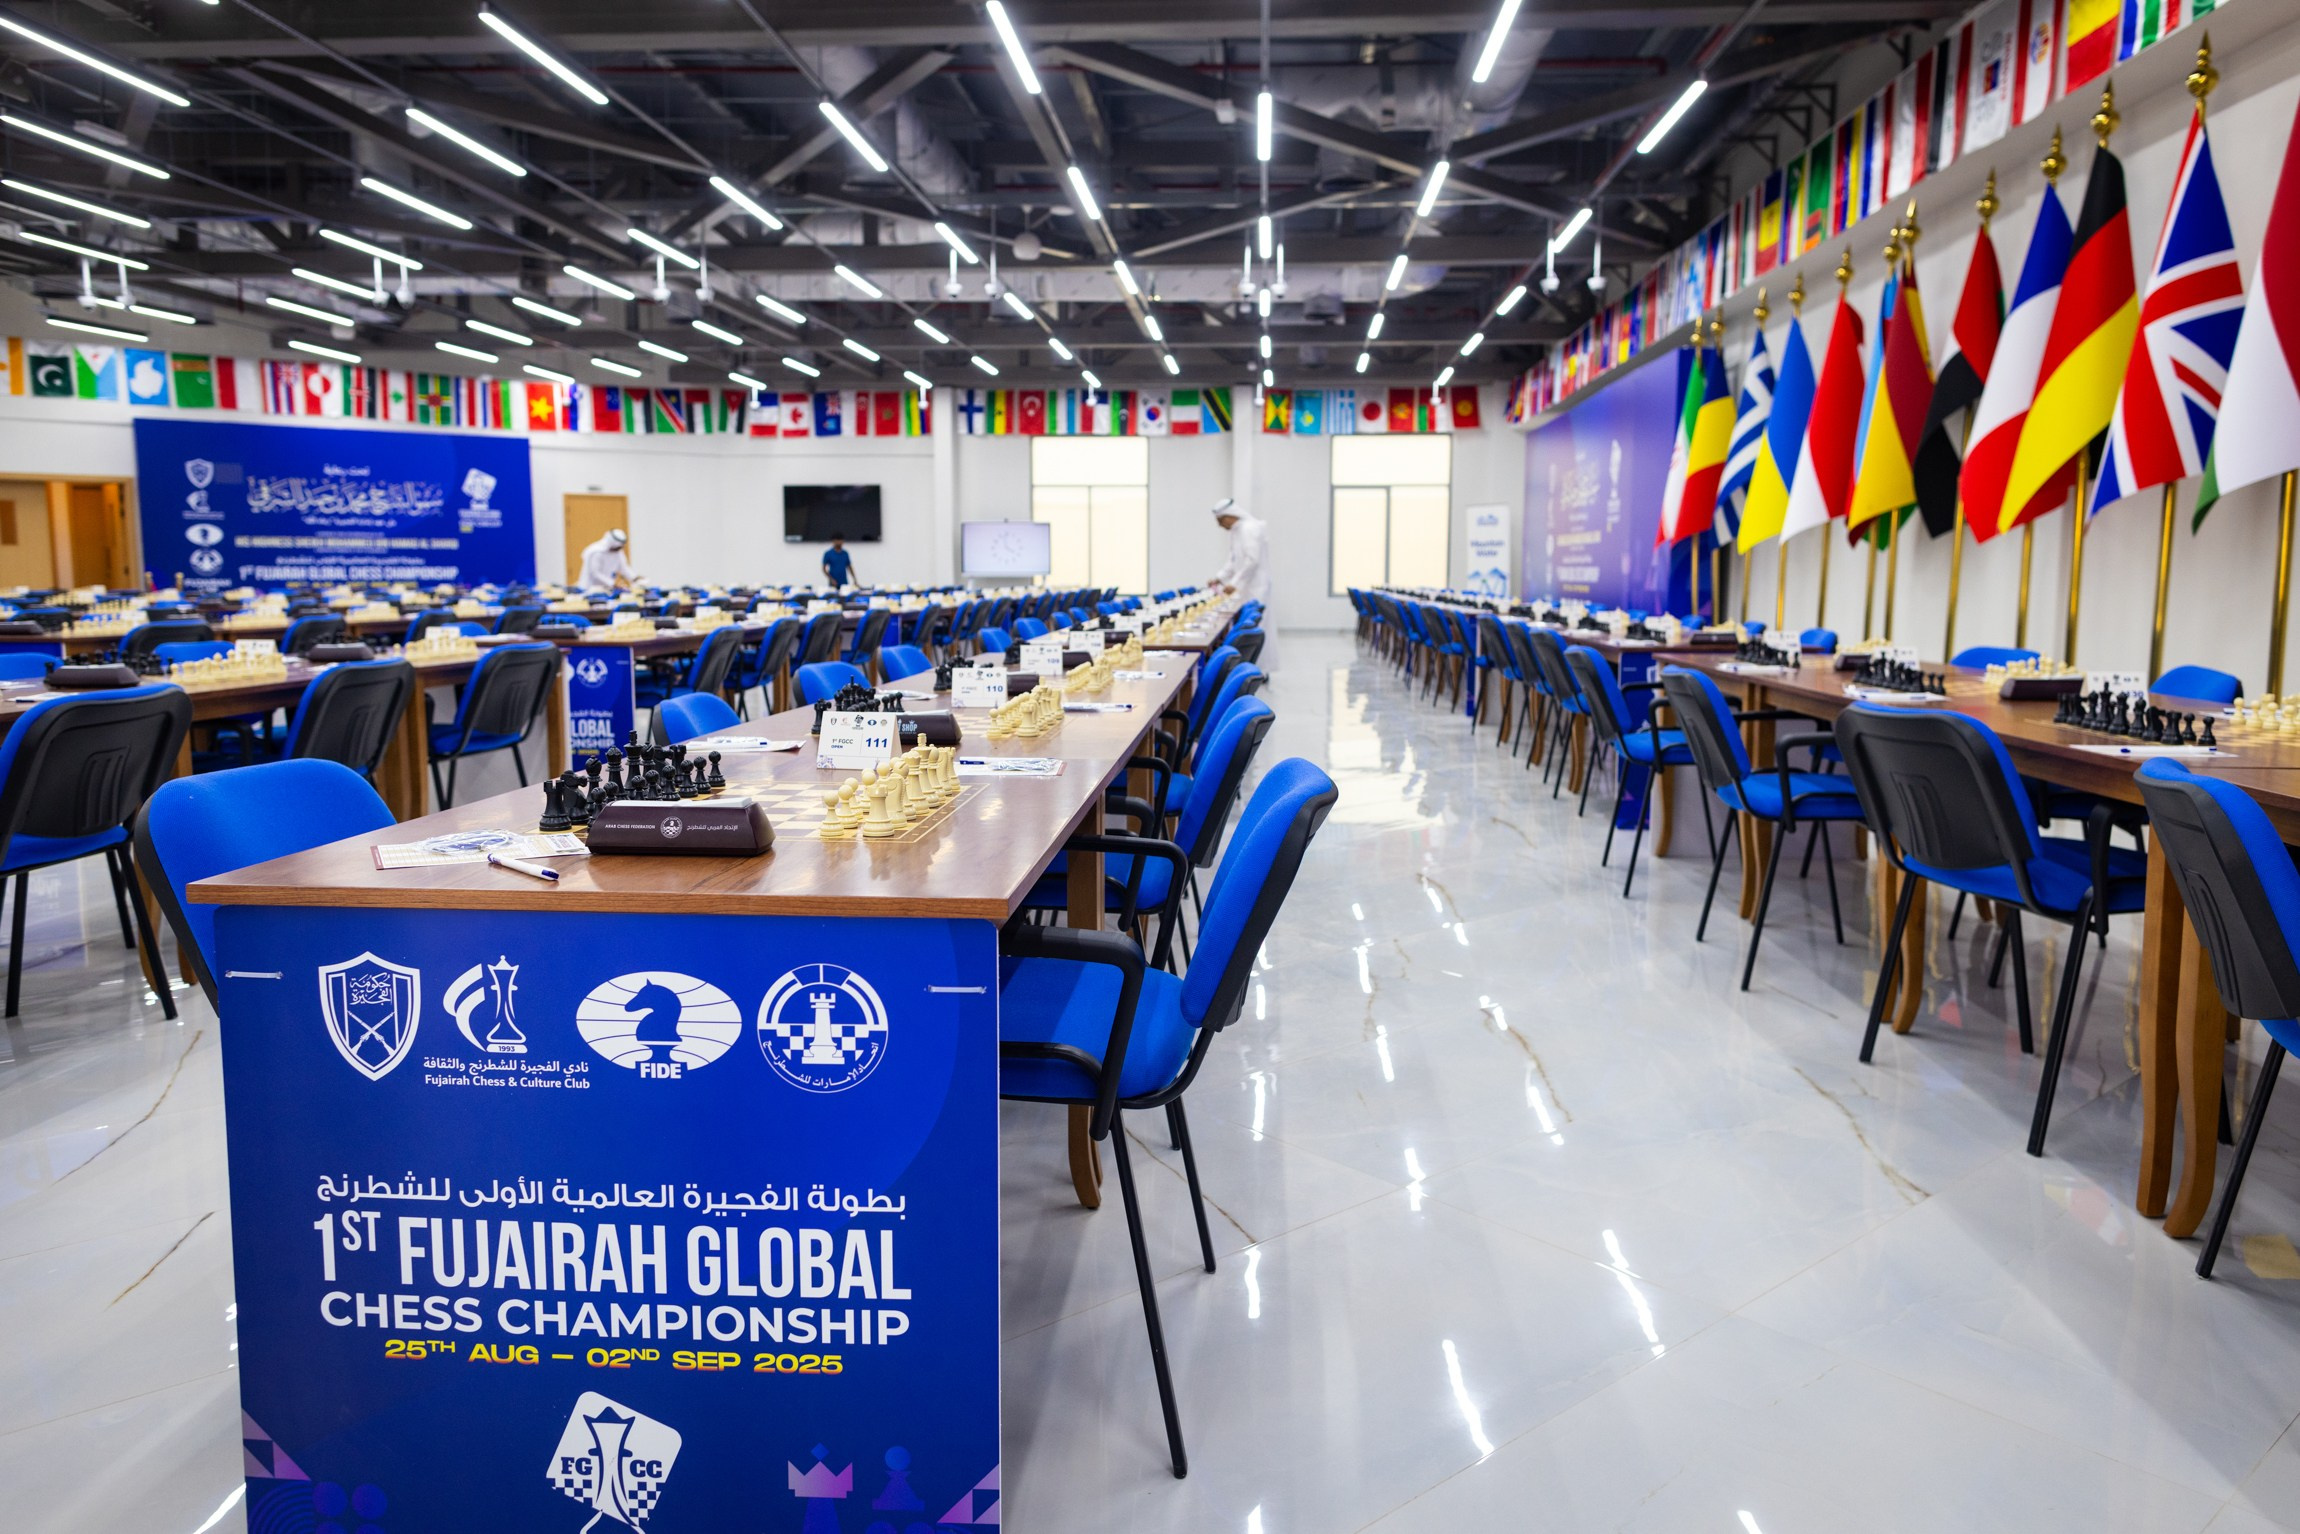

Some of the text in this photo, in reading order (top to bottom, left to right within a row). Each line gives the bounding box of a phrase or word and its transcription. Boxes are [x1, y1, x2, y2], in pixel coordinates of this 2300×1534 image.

[571, 719, 615, 738] LOBAL
[866, 738, 888, 748] 111
[423, 1056, 589, 1078] نادي الفجيرة للشطرنج والثقافة
[640, 1063, 682, 1079] FIDE
[425, 1075, 590, 1089] Fujairah Chess & Culture Club
[317, 1170, 906, 1220] بطولة الفجيرة العالمية الأولى للشطرنج
[313, 1210, 912, 1300] 1ST FUJAIRAH GLOBAL
[320, 1291, 910, 1345] CHESS CHAMPIONSHIP
[384, 1339, 456, 1360] 25TH
[467, 1343, 540, 1365] AUG
[586, 1347, 660, 1368] 02ND
[671, 1350, 741, 1372] SEP
[753, 1353, 844, 1375] 2025
[560, 1457, 663, 1478] FG CC
